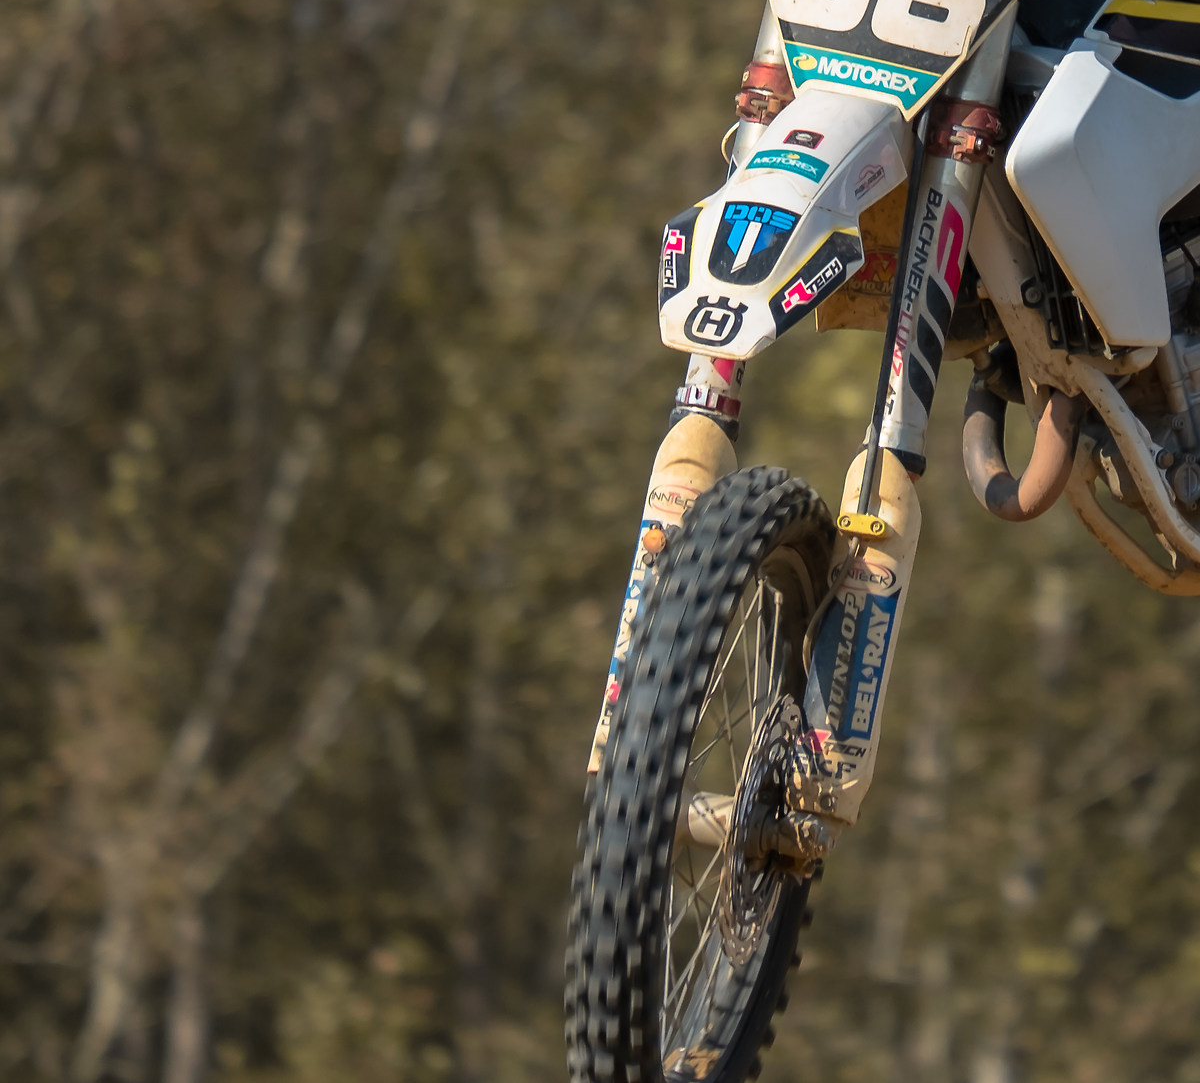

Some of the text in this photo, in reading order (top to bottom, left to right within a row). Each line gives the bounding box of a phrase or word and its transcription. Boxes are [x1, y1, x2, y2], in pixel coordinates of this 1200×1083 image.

[817, 56, 920, 96] MOTOREX
[754, 156, 819, 175] MOTOREX
[828, 592, 862, 732] DUNLOP
